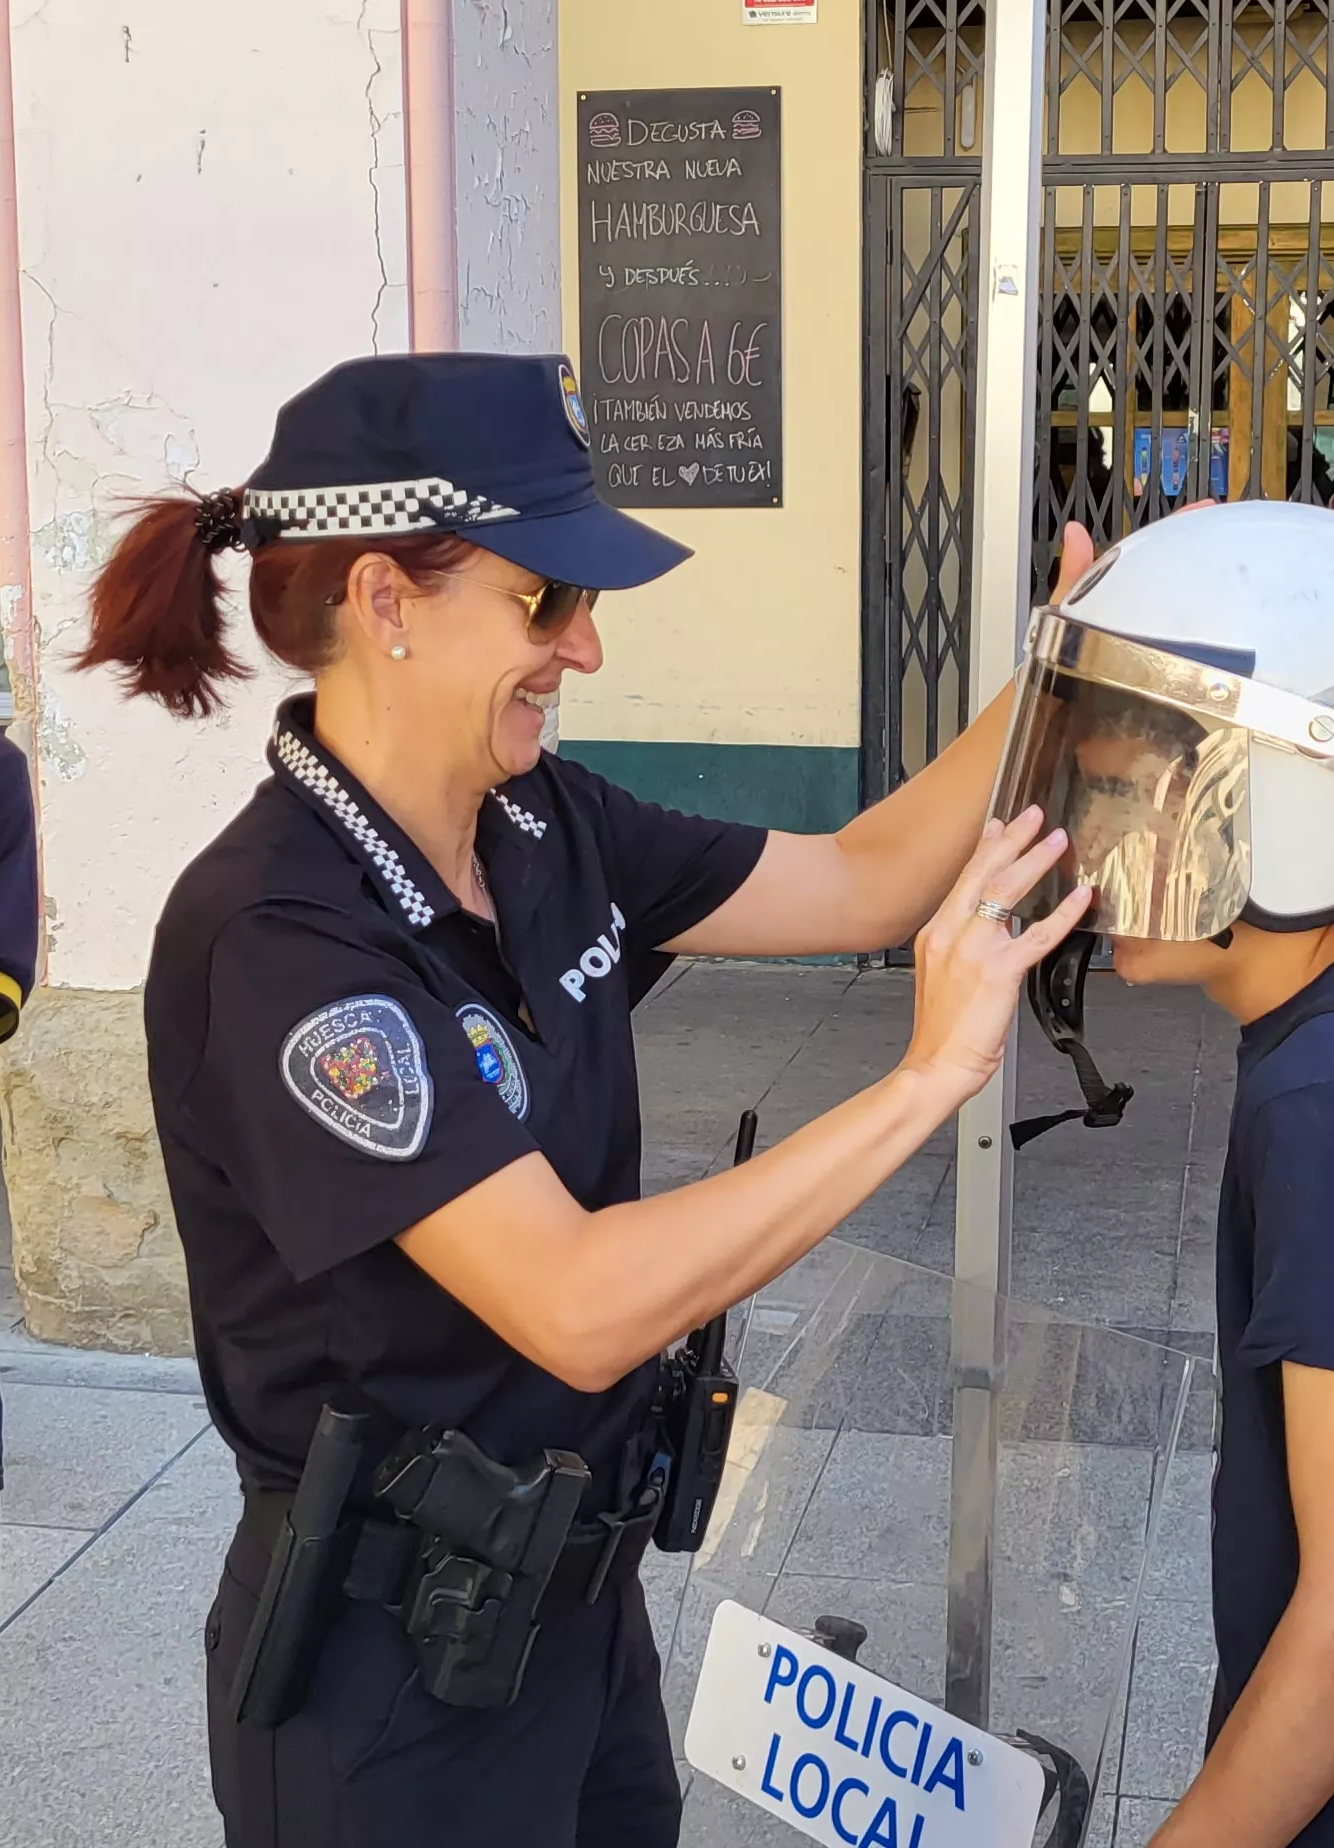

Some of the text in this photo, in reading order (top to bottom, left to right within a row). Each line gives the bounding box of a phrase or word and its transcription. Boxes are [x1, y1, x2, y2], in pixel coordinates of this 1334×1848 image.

[627, 119, 727, 146] DEGUSTA
[587, 157, 742, 185] NUESTRA NUEVA
[591, 200, 760, 243] HAMBURGUESA
[598, 314, 767, 386] COPAS A 6€
[674, 400, 751, 422] VENDEMOS
[600, 432, 620, 453] LA
[695, 427, 724, 449] MÁS
[729, 427, 763, 450] FRÍA
[652, 465, 676, 486] EL
[298, 1011, 374, 1058] HUESCA
[763, 1643, 966, 1812] POLICIA
